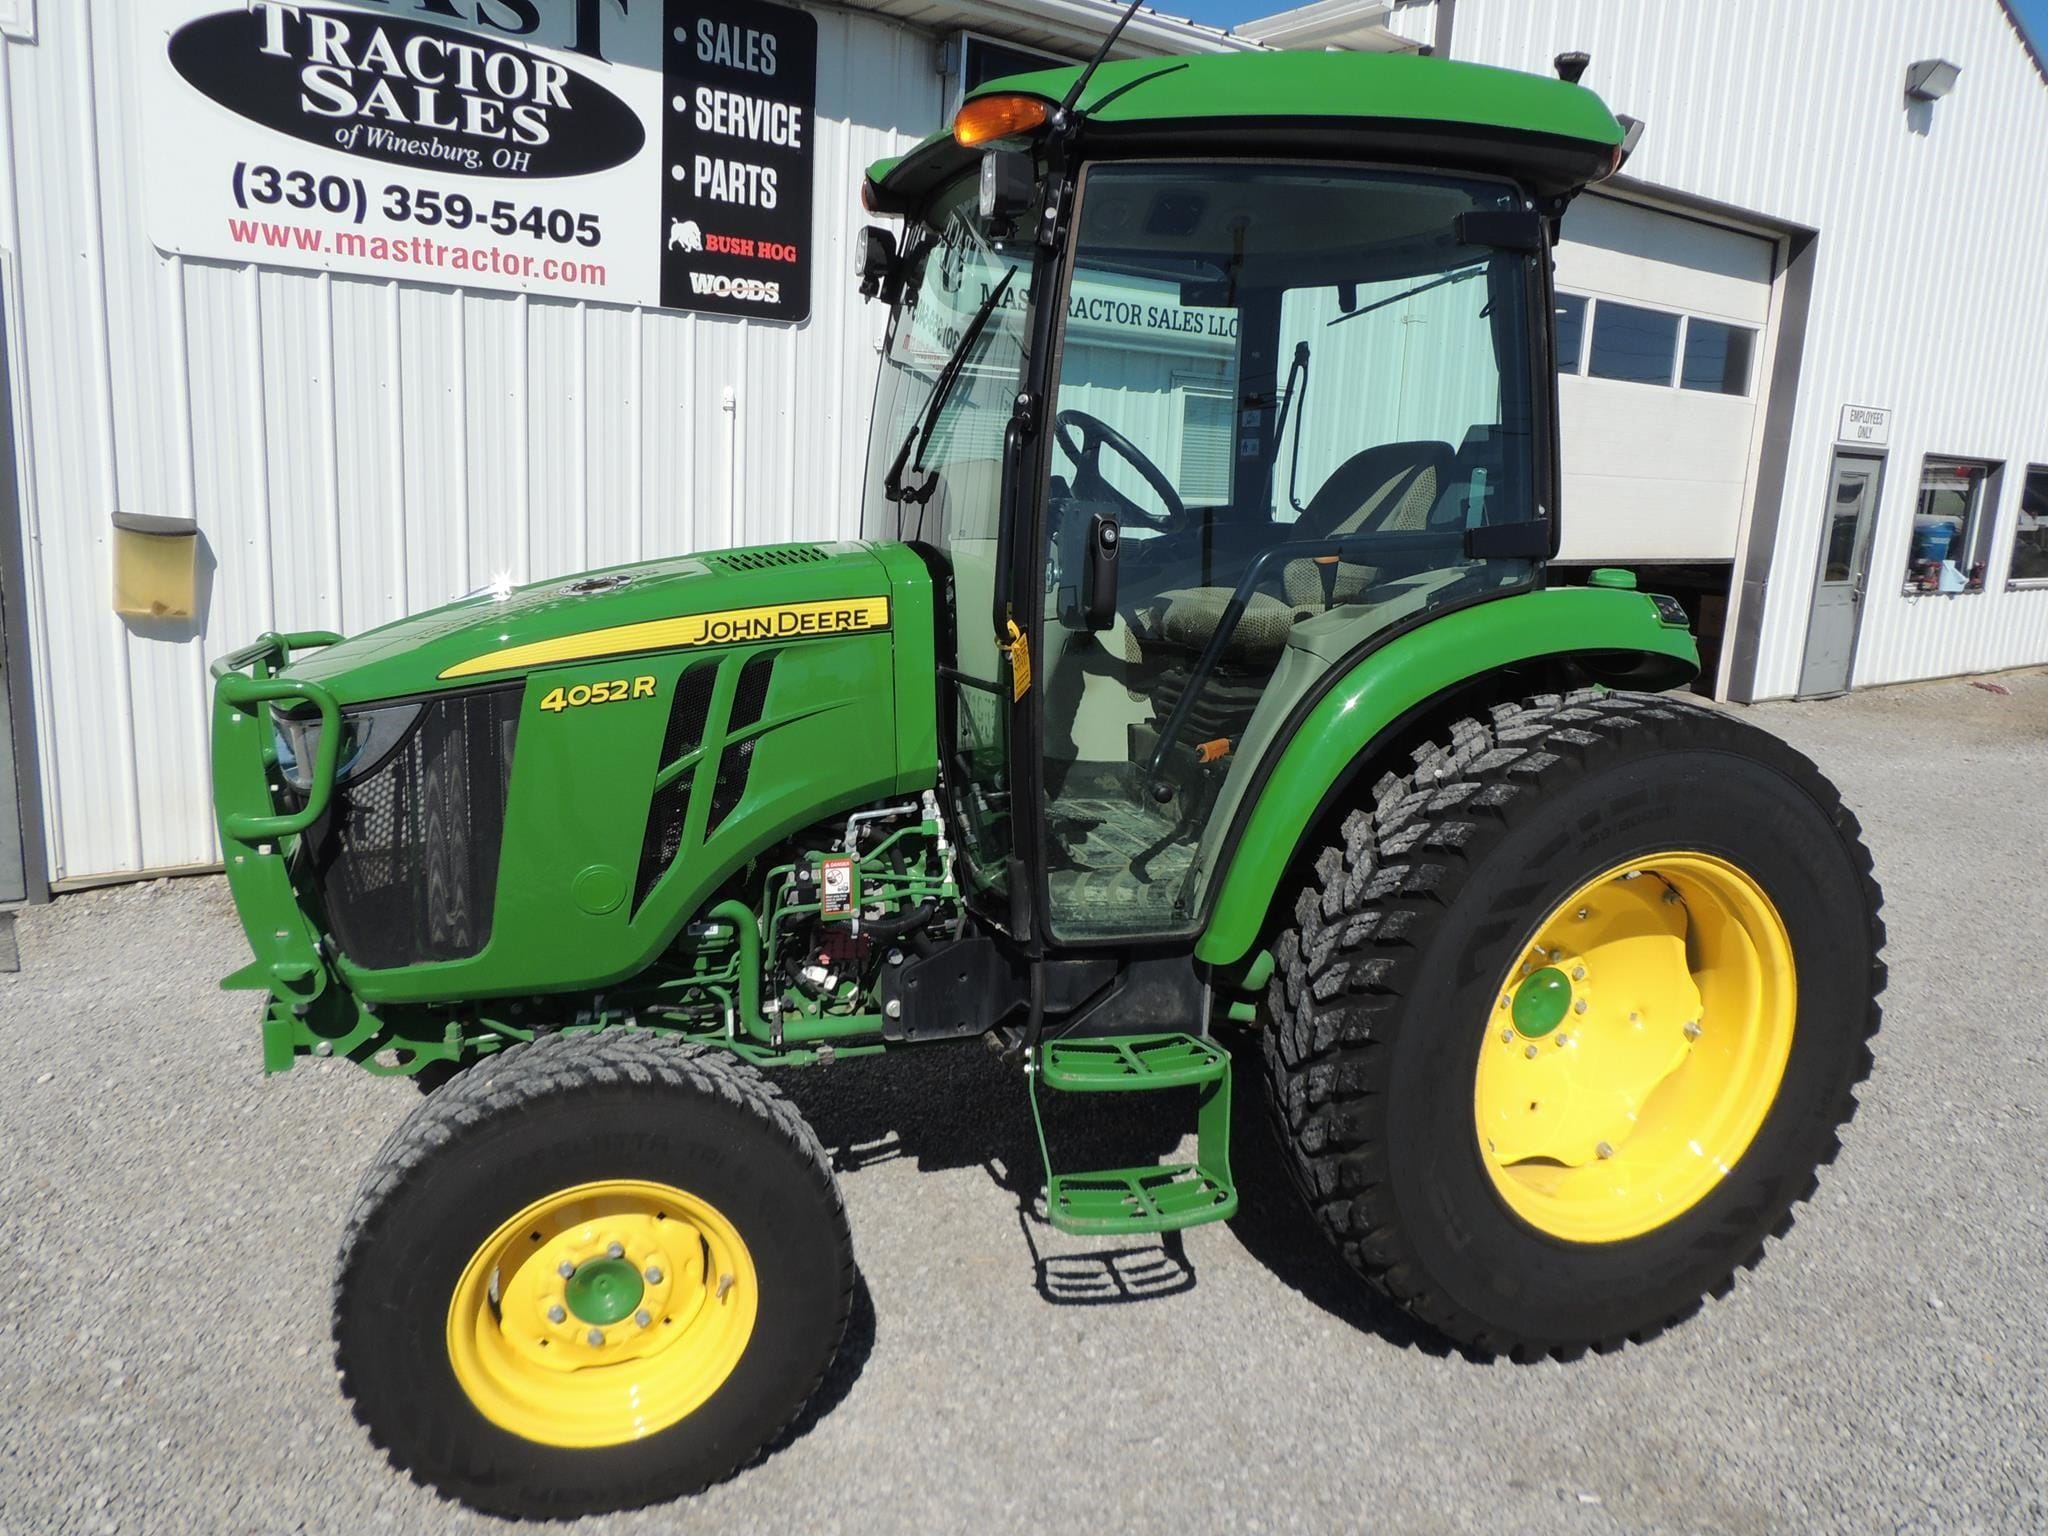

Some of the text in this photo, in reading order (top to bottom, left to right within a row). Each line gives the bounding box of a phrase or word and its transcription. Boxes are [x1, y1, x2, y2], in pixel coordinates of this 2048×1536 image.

[249, 1, 573, 109] TRACTOR
[697, 18, 777, 76] SALES
[301, 65, 550, 145] SALES
[695, 86, 801, 148] SERVICE
[335, 125, 531, 172] of Winesburg, OH
[232, 161, 602, 247] (330) 359-5405
[694, 155, 777, 209] PARTS
[228, 217, 607, 286] www.masttractor.com
[705, 234, 796, 263] BUSH HOG
[689, 271, 780, 304] WOODS
[1067, 296, 1142, 326] RACTOR
[1147, 306, 1204, 334] SALES
[1850, 409, 1883, 425] EMPLOYEES
[1857, 425, 1873, 438] ONLY
[694, 609, 869, 643] JOHN DEERE
[540, 675, 657, 713] 4052R
